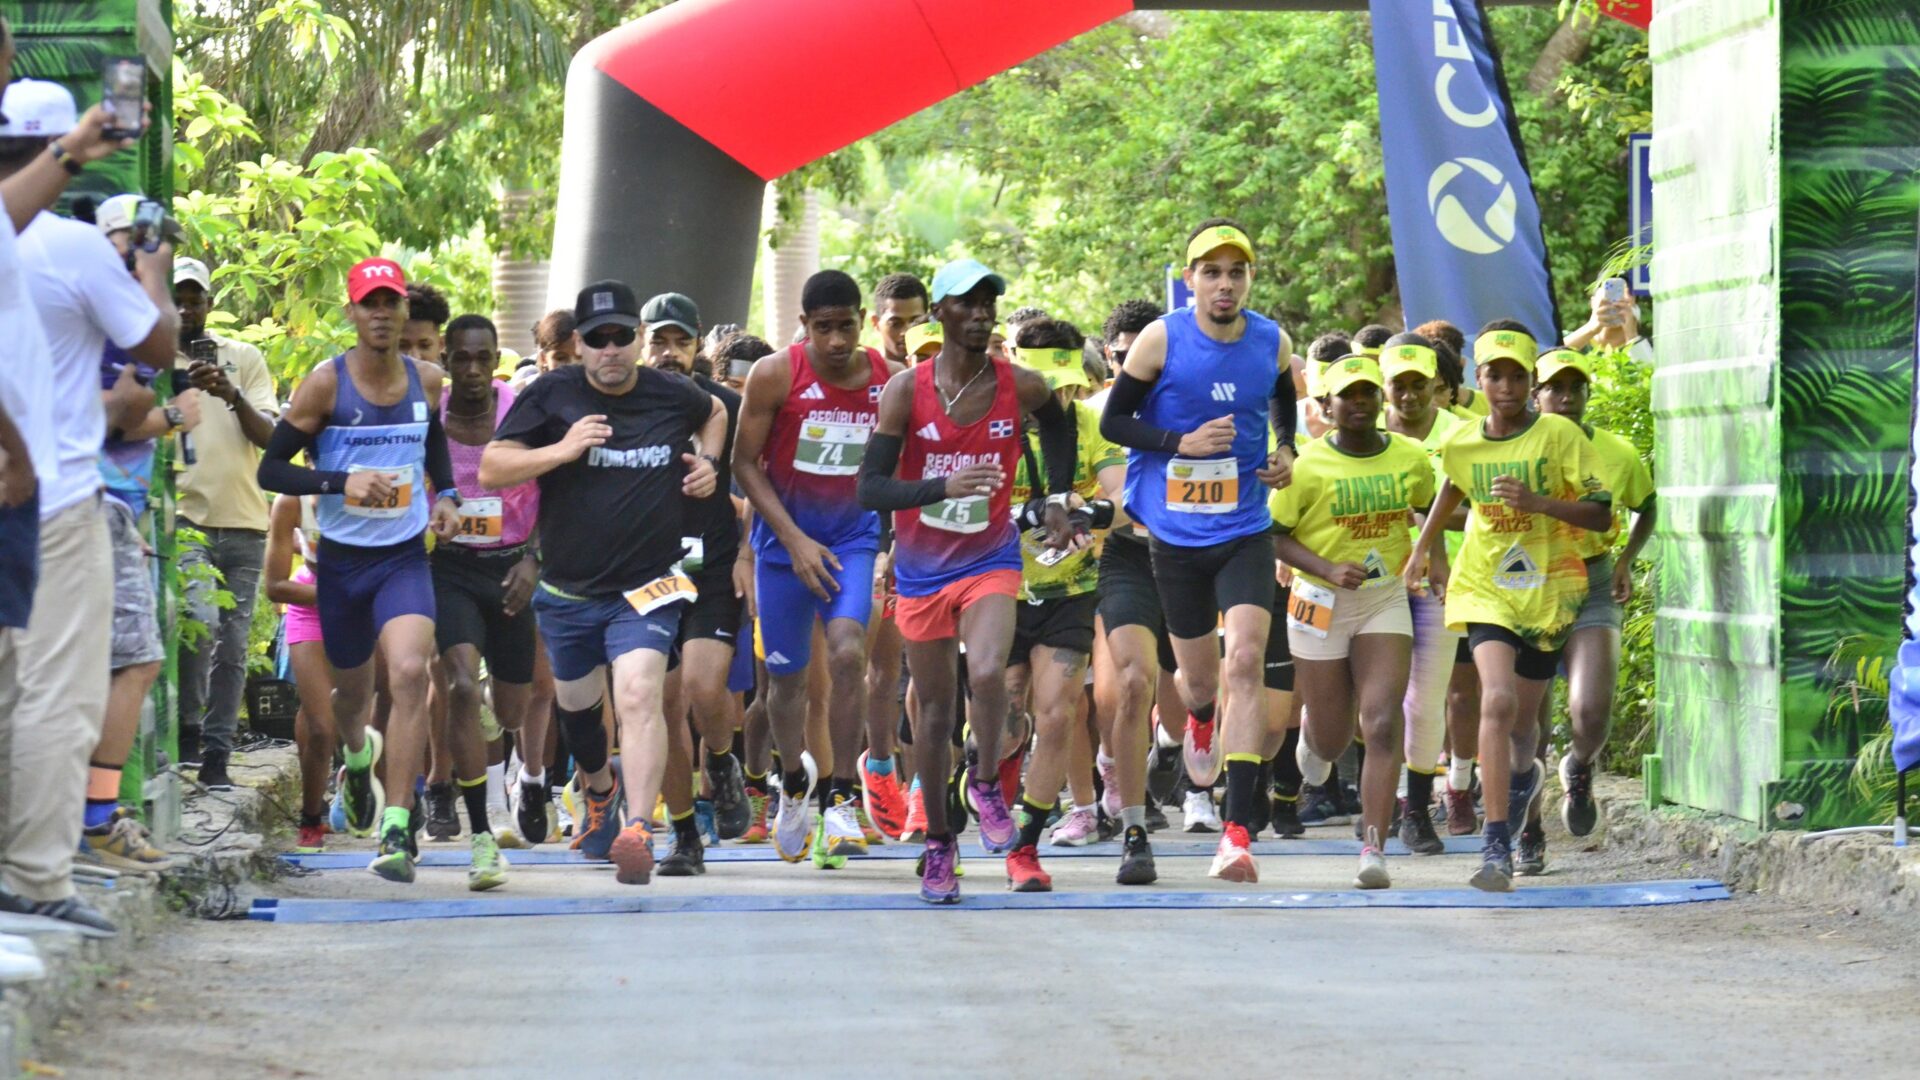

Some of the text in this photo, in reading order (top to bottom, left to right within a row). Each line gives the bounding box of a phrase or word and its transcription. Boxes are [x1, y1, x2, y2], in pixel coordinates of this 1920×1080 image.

[362, 265, 394, 278] TYR
[344, 434, 422, 446] ARGENTINA
[817, 443, 844, 465] 74
[1182, 482, 1223, 503] 210
[1331, 472, 1408, 516] JUNGLE
[941, 500, 971, 523] 75
[462, 518, 489, 536] 45
[1490, 516, 1532, 532] 2025
[644, 577, 680, 600] 107
